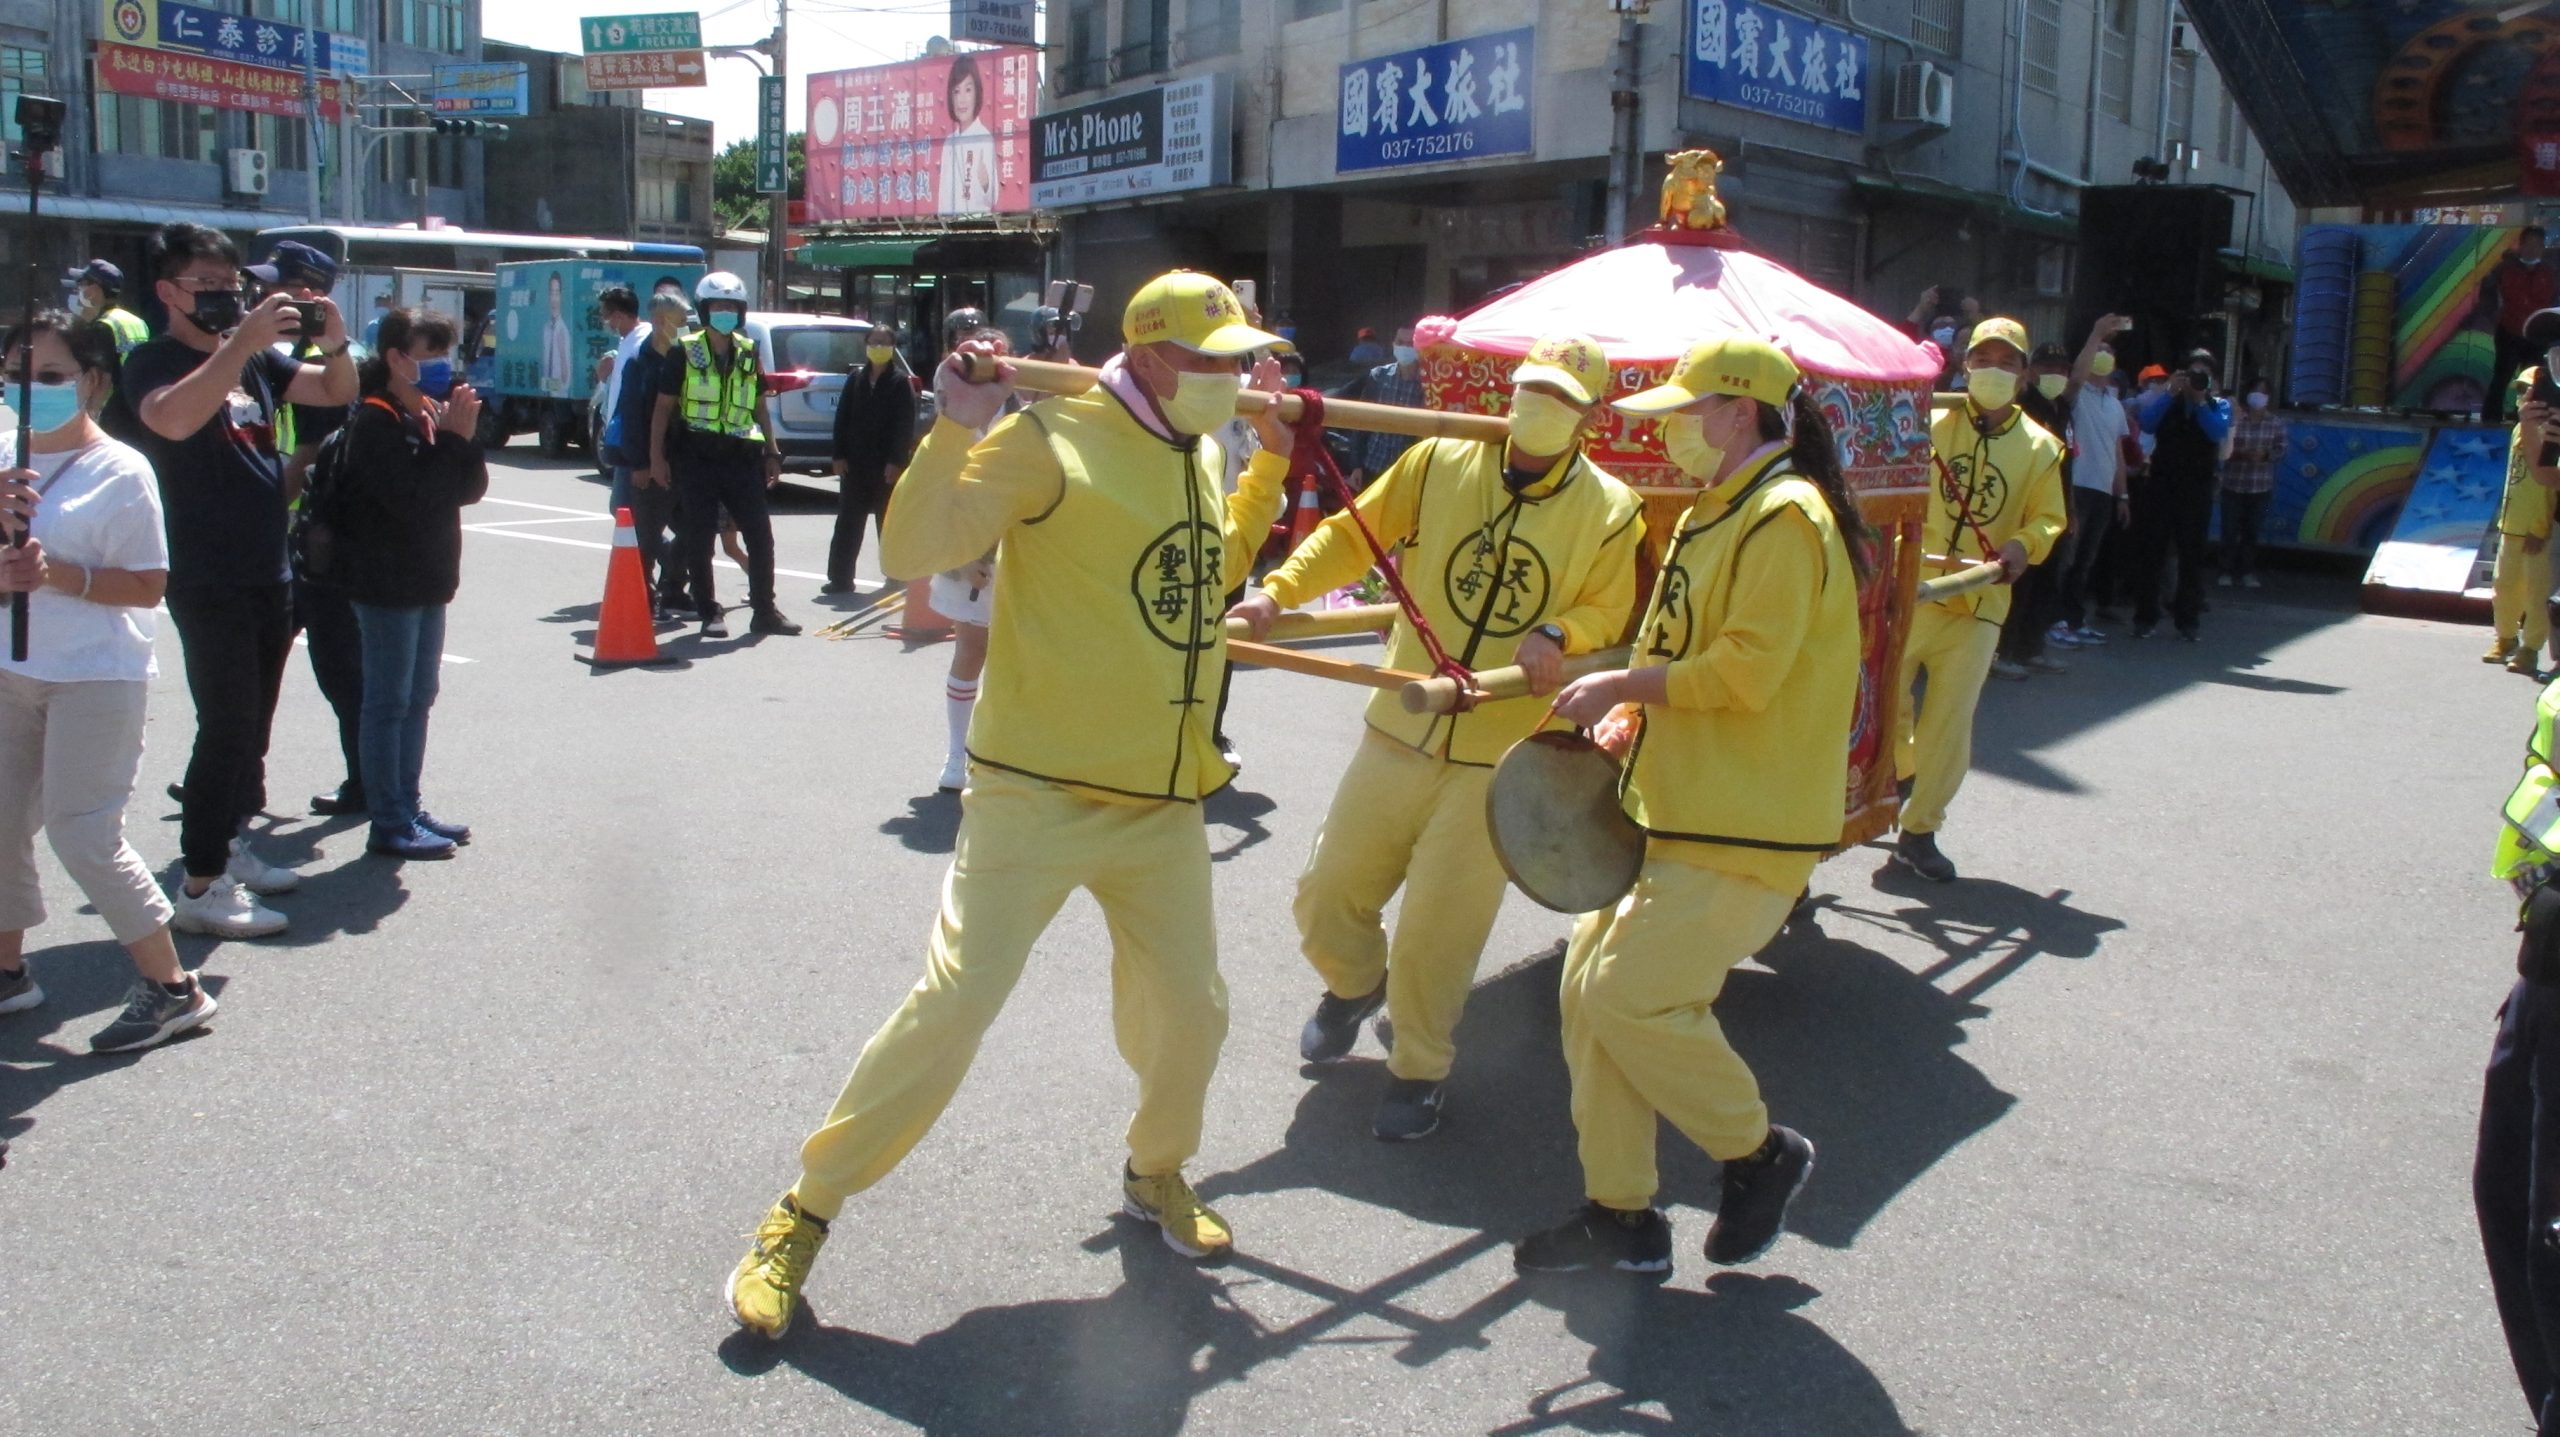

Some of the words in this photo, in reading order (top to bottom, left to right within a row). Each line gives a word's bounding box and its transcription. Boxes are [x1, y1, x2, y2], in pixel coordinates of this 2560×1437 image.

[638, 35, 692, 48] FREEWAY
[1696, 0, 1861, 101] 國賓大旅社
[843, 90, 912, 134] 周玉滿
[1343, 42, 1525, 138] 國賓大旅社
[1741, 84, 1825, 119] 037-752176
[1044, 117, 1078, 157] Mr's
[1082, 111, 1143, 150] Phone
[1381, 131, 1474, 160] 037-752176
[1152, 543, 1188, 624] 聖母
[1494, 558, 1532, 625] 天上
